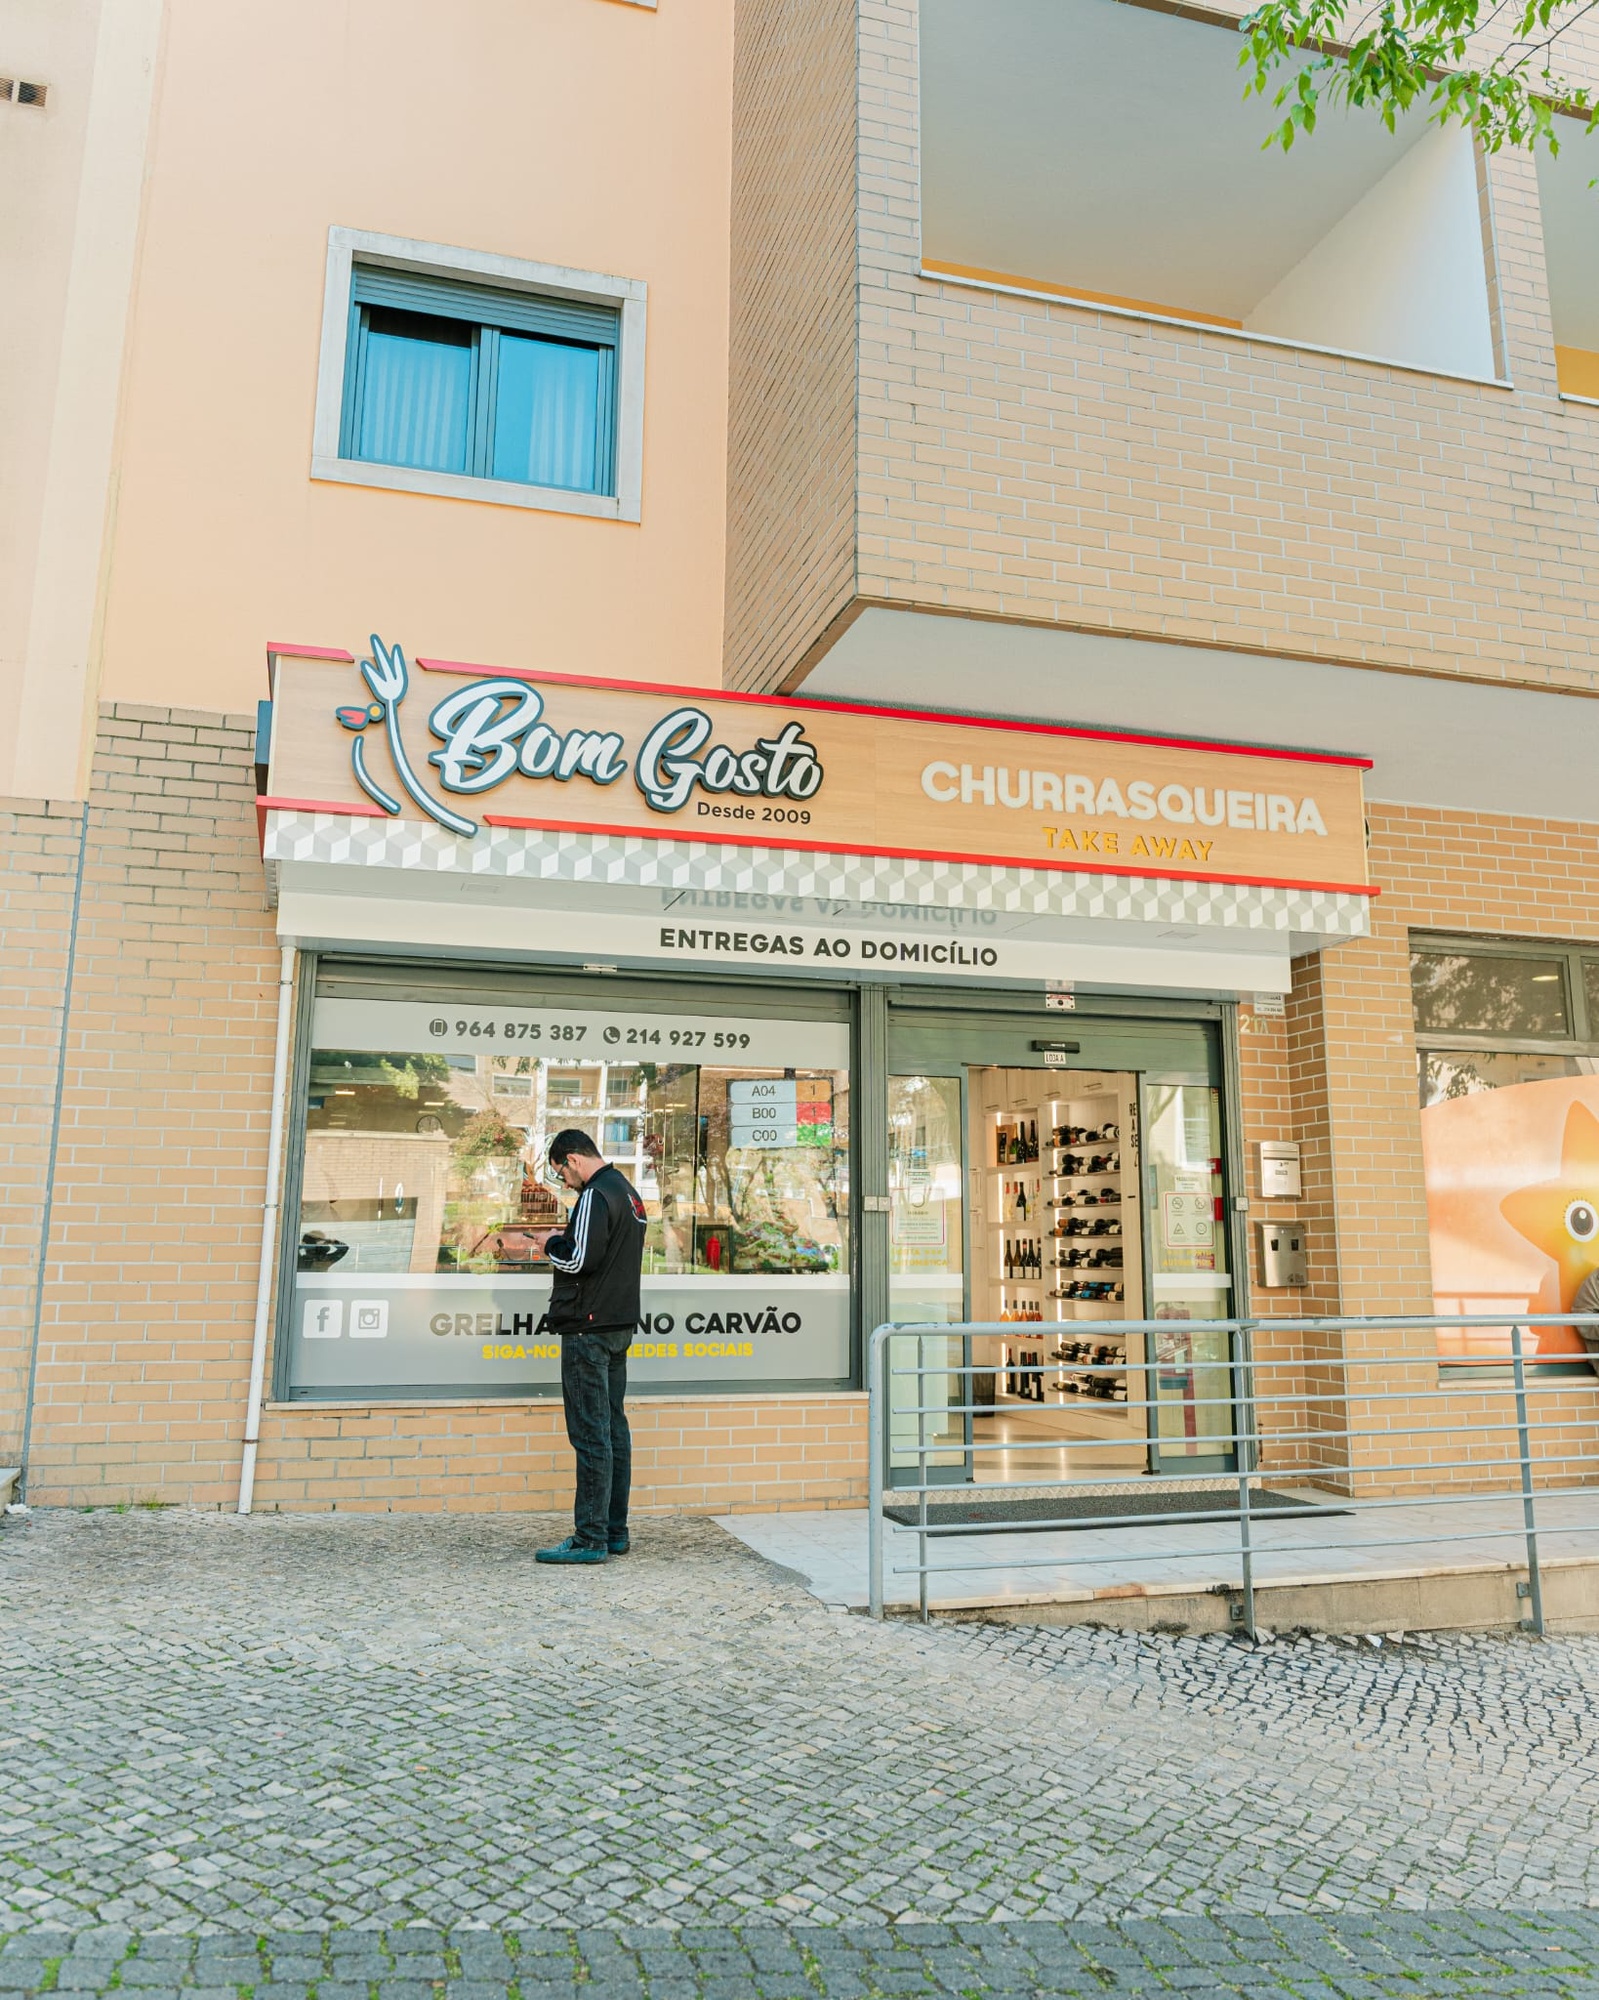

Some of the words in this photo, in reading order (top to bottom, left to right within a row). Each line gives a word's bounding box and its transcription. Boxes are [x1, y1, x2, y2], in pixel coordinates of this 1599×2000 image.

[428, 677, 627, 794] Bom
[635, 707, 824, 813] Gosto
[921, 761, 1328, 836] CHURRASQUEIRA
[697, 801, 755, 820] Desde
[762, 807, 811, 825] 2009
[1042, 826, 1119, 854] TAKE
[1131, 835, 1214, 862] AWAY
[660, 928, 804, 956] ENTREGAS
[813, 938, 851, 958] AO
[861, 941, 998, 967] DOMICÍLIO
[455, 1020, 496, 1037] 964
[504, 1023, 542, 1040] 875
[549, 1024, 588, 1041] 387
[626, 1028, 661, 1045] 214
[669, 1030, 706, 1047] 927
[713, 1032, 750, 1049] 599
[752, 1085, 776, 1096] A04
[810, 1085, 815, 1095] 1
[752, 1108, 776, 1119] B00
[752, 1130, 777, 1141] C00
[430, 1313, 561, 1336] GRELHA
[685, 1306, 802, 1334] CARVÃO
[482, 1344, 561, 1359] SIGA-NO
[683, 1342, 754, 1357] SOCIAIS
